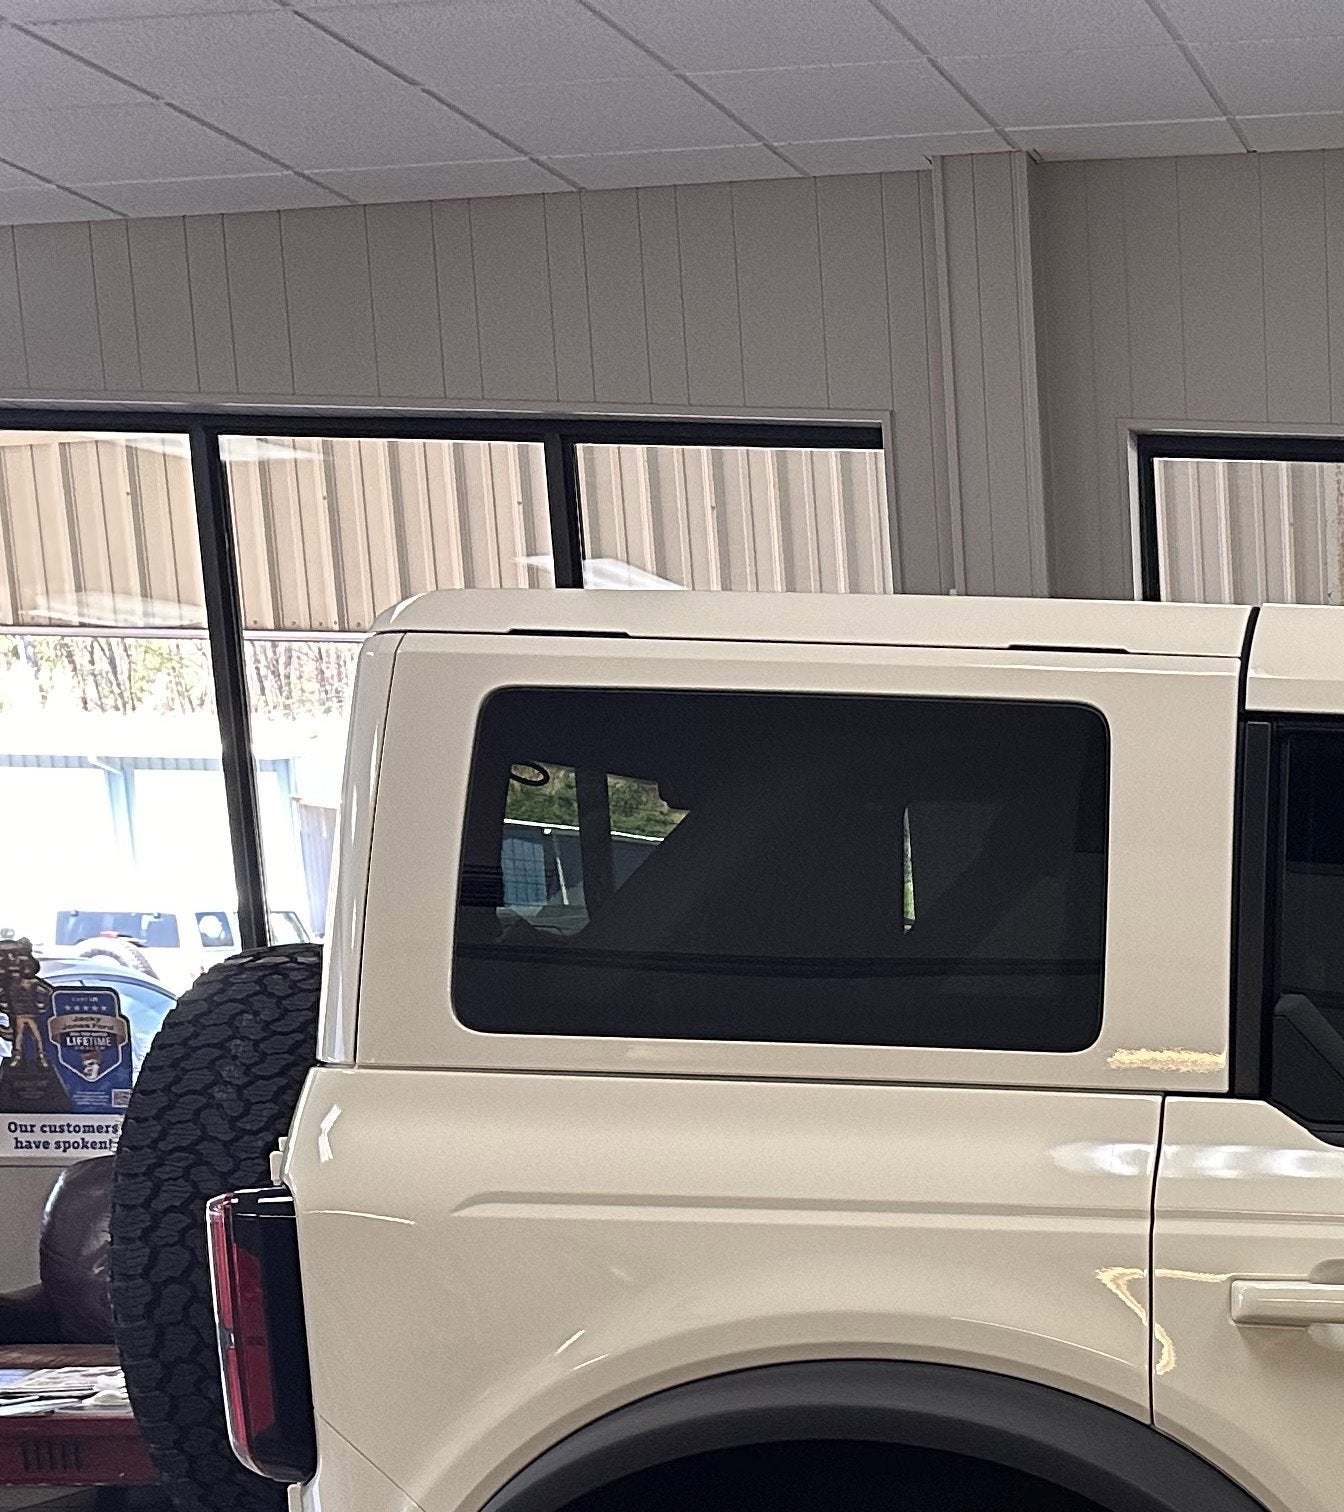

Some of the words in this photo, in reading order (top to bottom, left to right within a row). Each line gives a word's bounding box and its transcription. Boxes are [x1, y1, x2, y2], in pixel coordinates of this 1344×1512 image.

[66, 1036, 112, 1047] LIFETIME
[7, 1121, 36, 1134] Our
[40, 1122, 119, 1134] customers
[14, 1137, 50, 1150] have
[54, 1138, 113, 1153] spoken!
